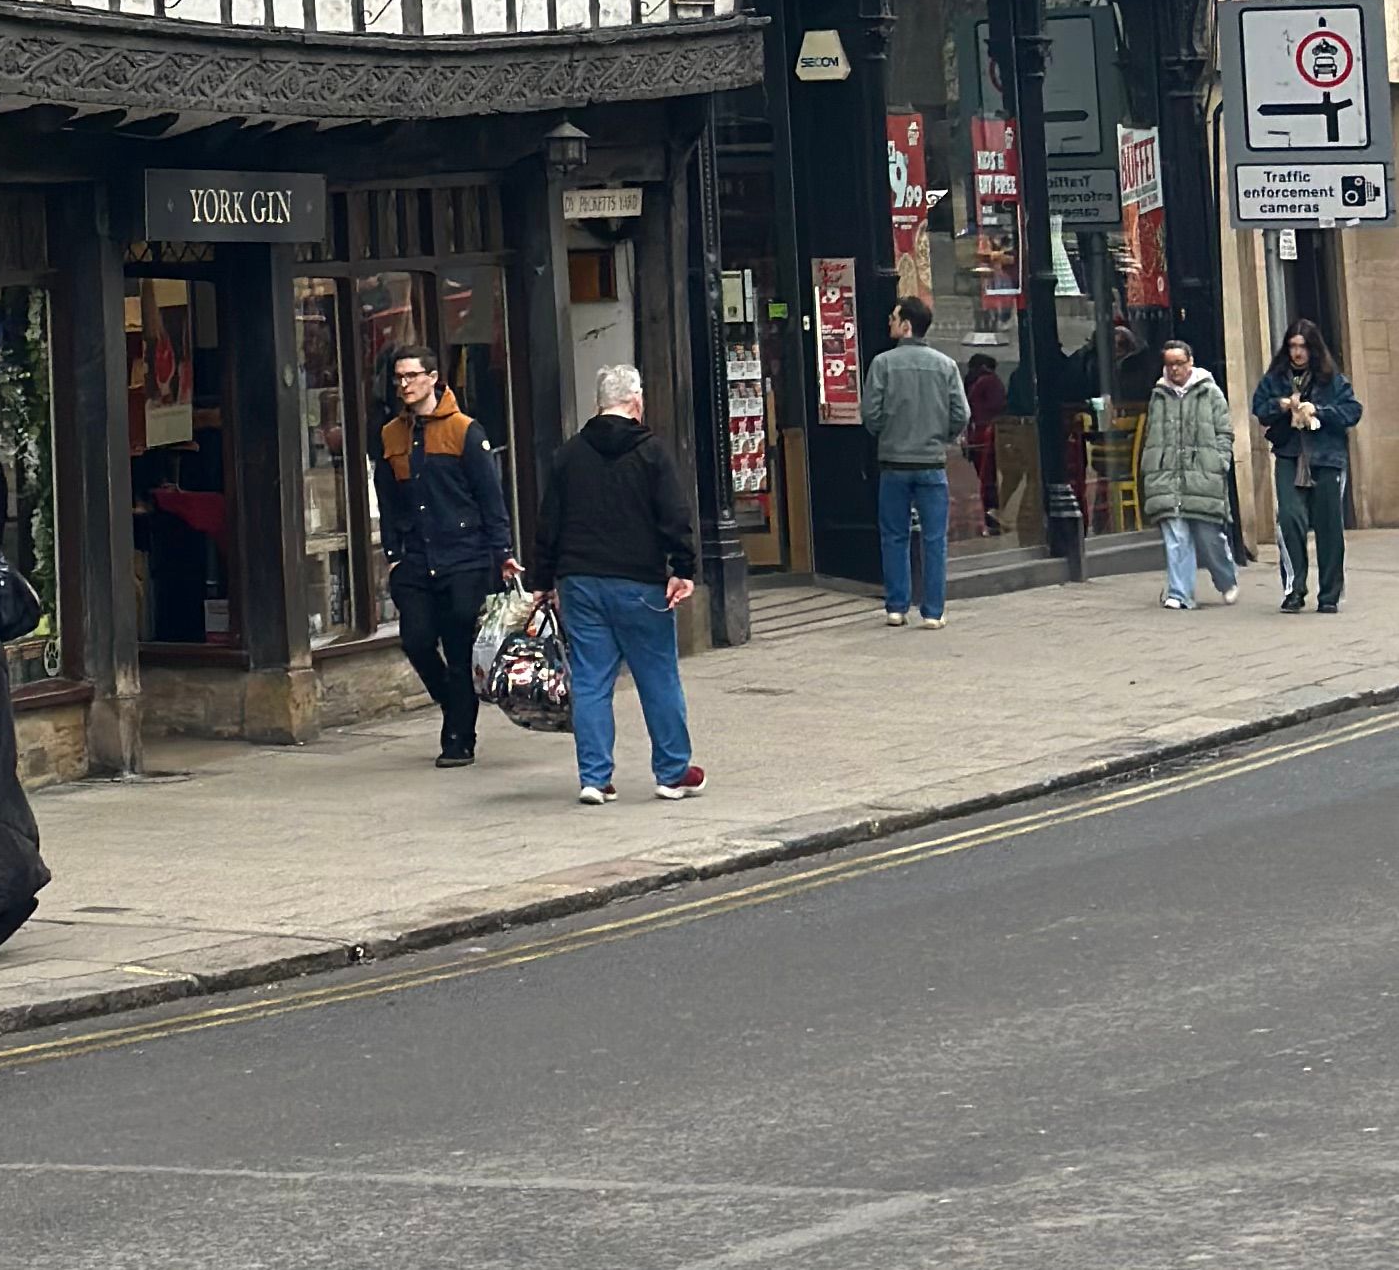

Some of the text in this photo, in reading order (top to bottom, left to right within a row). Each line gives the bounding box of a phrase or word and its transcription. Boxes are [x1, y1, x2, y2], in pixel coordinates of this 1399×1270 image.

[800, 57, 839, 68] SECOM
[1263, 171, 1311, 183] Traffic
[1243, 186, 1335, 198] enforcement
[189, 189, 292, 223] YORK GIN
[1260, 203, 1320, 214] cameras
